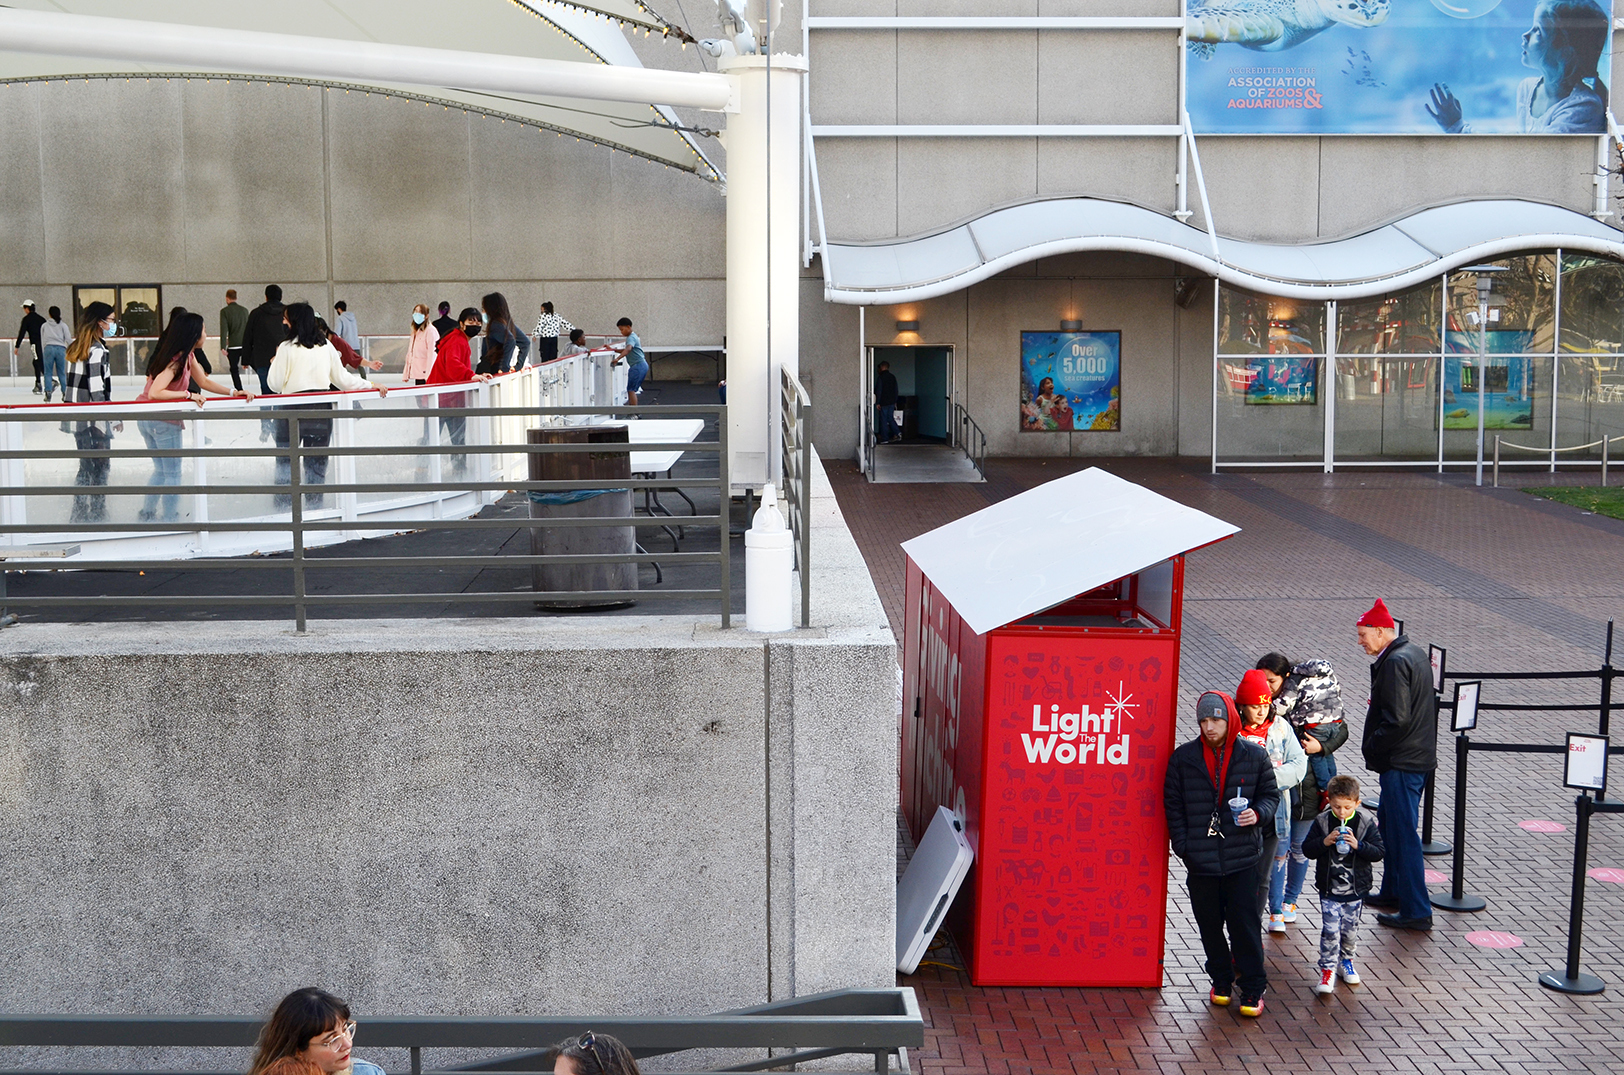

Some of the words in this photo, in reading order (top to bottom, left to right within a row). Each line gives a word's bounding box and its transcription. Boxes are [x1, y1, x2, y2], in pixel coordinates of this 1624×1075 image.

[1227, 77, 1316, 87] ASSOCIATION
[1227, 99, 1303, 109] AQUARIUMS
[1248, 88, 1266, 98] OF
[1267, 88, 1303, 98] ZOOS
[1303, 87, 1323, 109] &
[1072, 344, 1098, 357] Over
[1063, 357, 1107, 374] 5,000
[917, 585, 962, 750] Giving
[1032, 704, 1115, 741] Light
[1079, 733, 1097, 743] The
[1020, 733, 1130, 765] World
[1569, 743, 1586, 752] Exit
